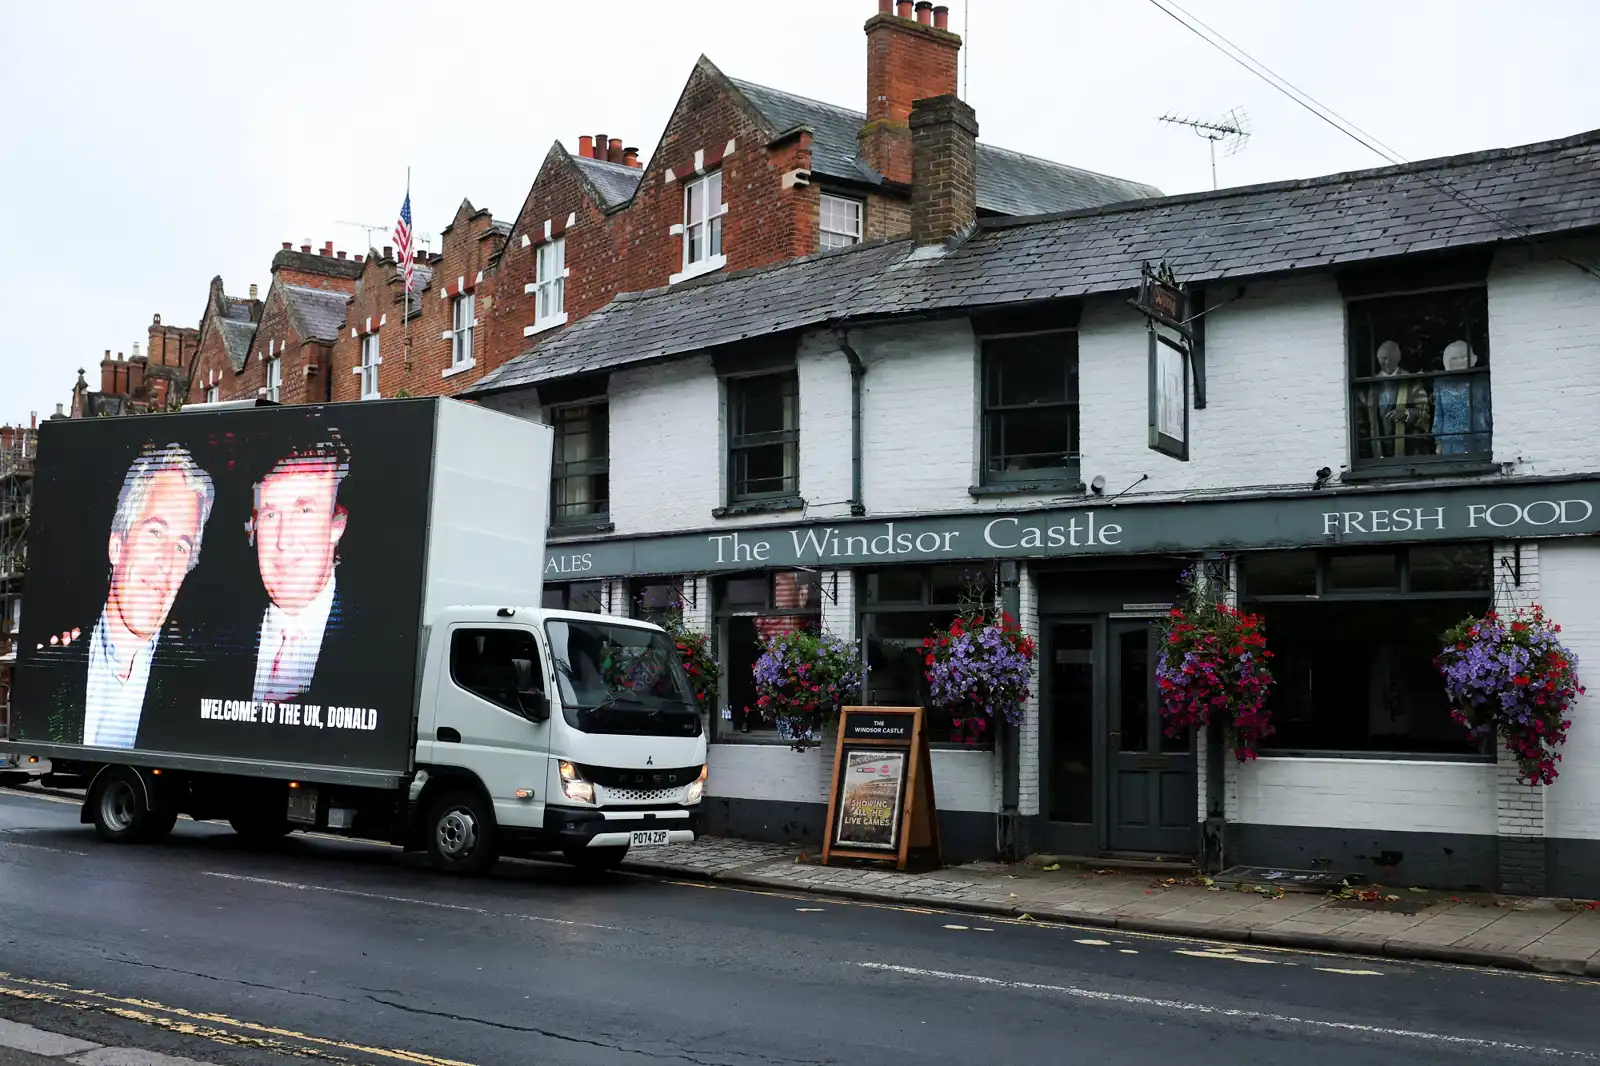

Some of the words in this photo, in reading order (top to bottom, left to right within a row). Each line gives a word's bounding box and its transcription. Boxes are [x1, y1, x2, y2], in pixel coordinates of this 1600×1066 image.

[1321, 507, 1445, 534] FRESH
[1466, 499, 1593, 528] FOOD
[708, 534, 770, 564] The
[789, 521, 960, 559] Windsor
[982, 511, 1123, 550] Castle
[544, 553, 592, 573] ALES
[200, 699, 257, 722] WELCOME
[261, 702, 276, 724] TO
[279, 703, 301, 725] THE
[303, 704, 323, 729] UK,
[327, 706, 377, 730] DONALD
[854, 726, 882, 734] WINDSOR
[619, 774, 677, 783] FUSO
[851, 798, 889, 808] SHOWING
[852, 808, 867, 817] ALL
[869, 808, 884, 817] THE
[844, 816, 862, 825] LIVE
[863, 818, 890, 827] GAMES
[653, 831, 666, 843] ZXP
